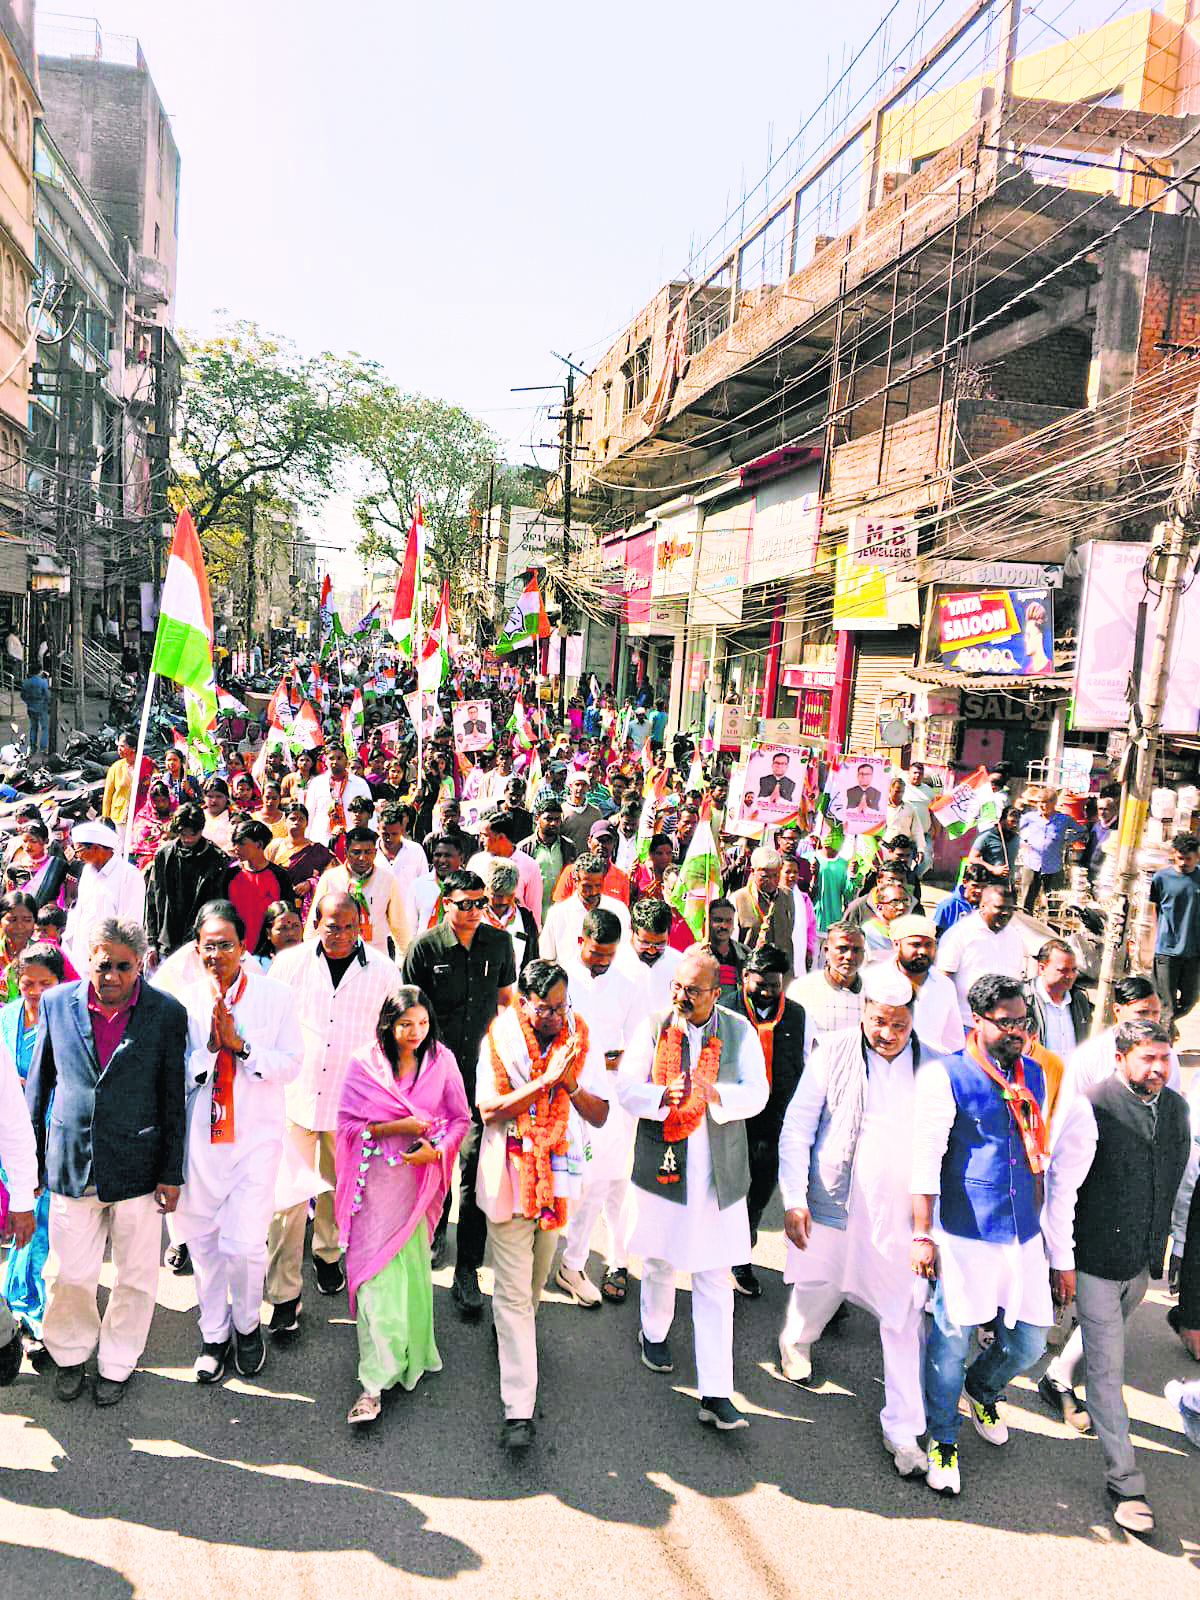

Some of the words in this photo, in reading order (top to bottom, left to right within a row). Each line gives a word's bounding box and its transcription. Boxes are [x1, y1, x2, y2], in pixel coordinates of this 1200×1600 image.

[858, 547, 911, 558] JEWELLERS
[979, 566, 1040, 585] SALOON
[948, 596, 982, 616] TATA
[943, 608, 1007, 641] SALOON
